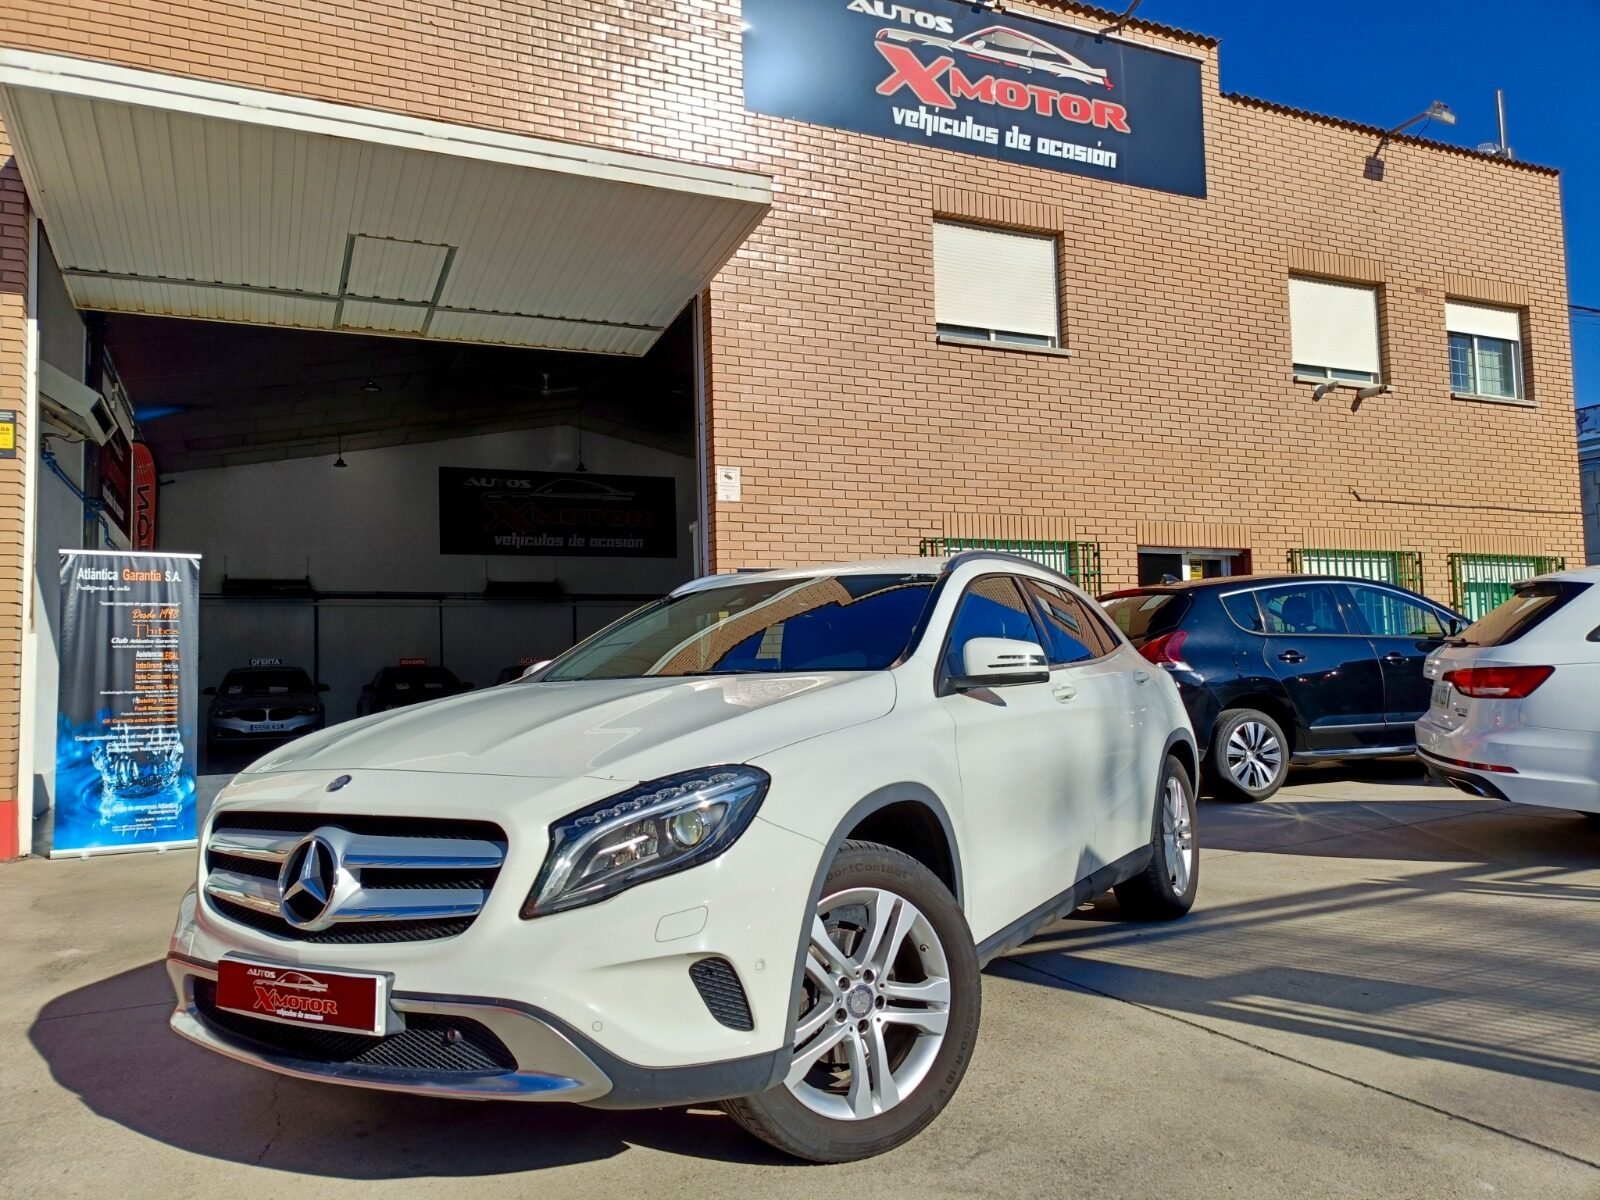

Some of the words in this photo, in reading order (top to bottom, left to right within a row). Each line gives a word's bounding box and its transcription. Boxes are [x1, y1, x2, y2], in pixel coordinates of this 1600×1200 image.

[847, 0, 954, 34] AUTOS
[874, 40, 1131, 134] XMOTOR
[892, 106, 999, 145] vehículos
[1005, 126, 1031, 150] de
[1037, 141, 1117, 169] ocasión
[463, 477, 531, 488] AUTOS
[568, 533, 585, 547] de
[77, 567, 118, 581] Atlántica
[165, 571, 182, 582] S.A.
[132, 608, 157, 619] Desde
[250, 658, 281, 666] OFERTA
[247, 968, 276, 979] AUTOS
[253, 985, 338, 1015] XMOTOR
